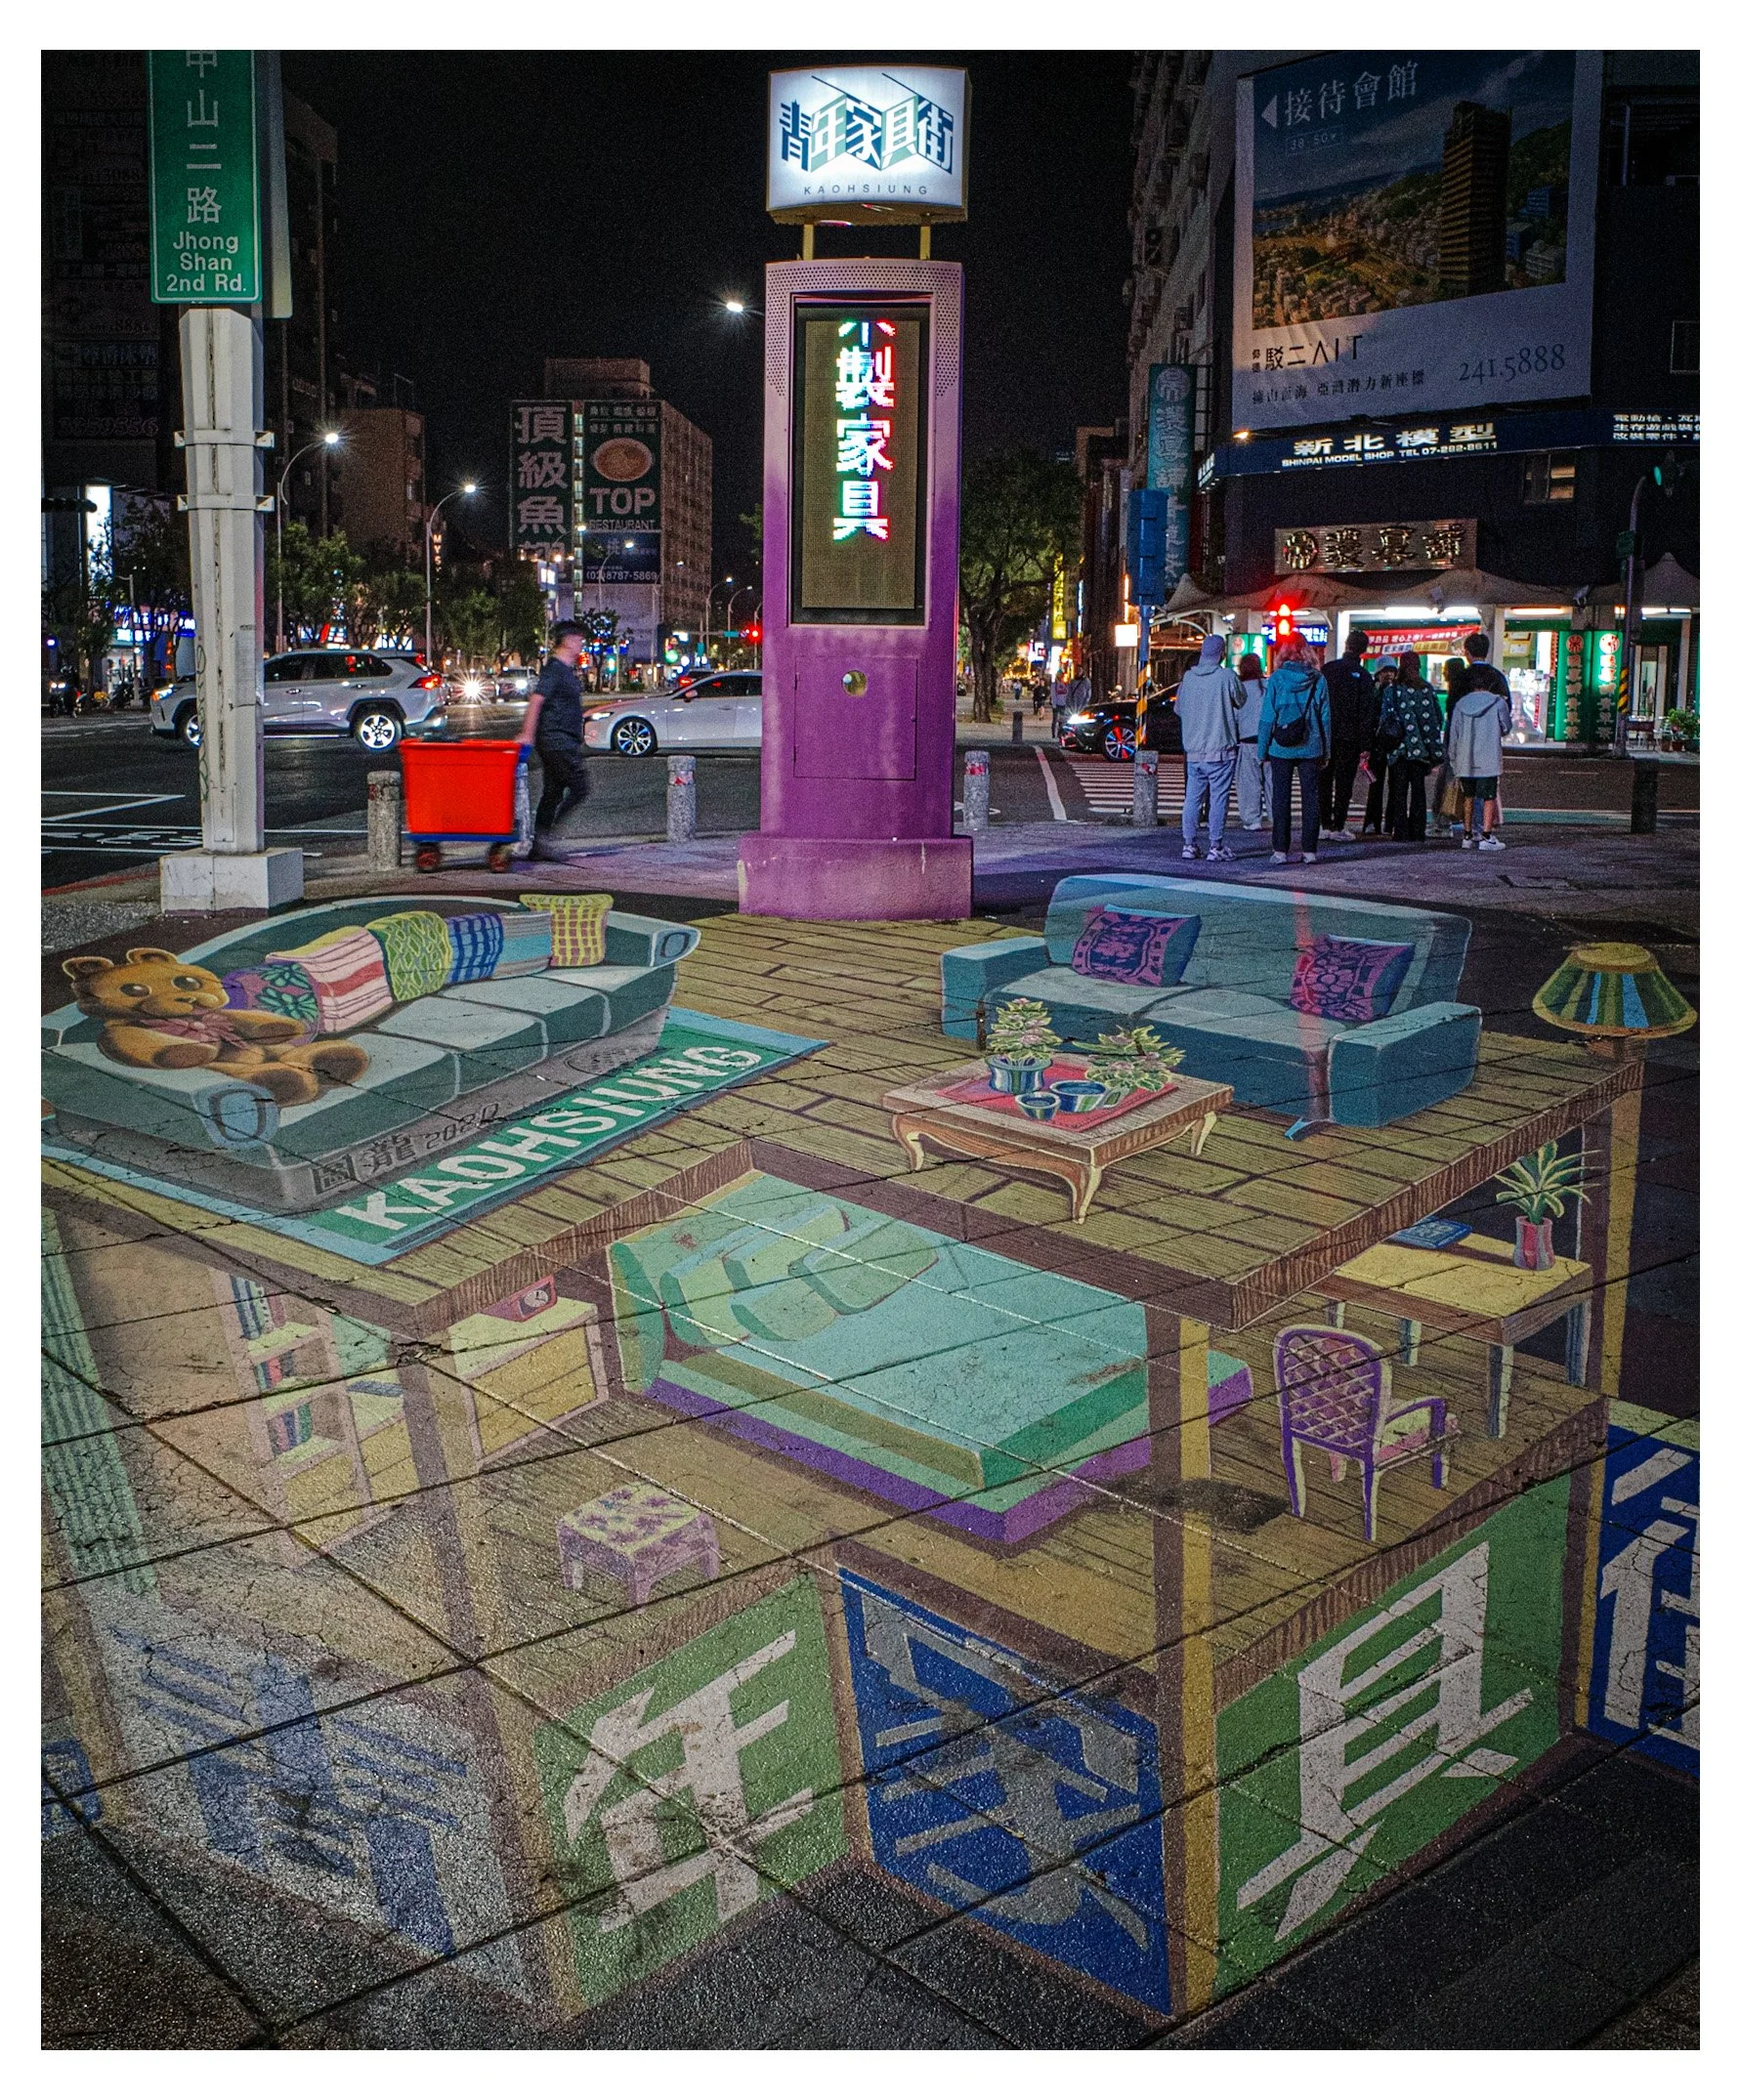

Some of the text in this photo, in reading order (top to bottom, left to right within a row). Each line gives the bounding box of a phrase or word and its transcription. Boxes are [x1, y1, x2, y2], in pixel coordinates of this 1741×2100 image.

[1285, 60, 1419, 126] 接待會館
[186, 50, 222, 224] 中山二路
[779, 94, 955, 175] 青年家具街
[804, 184, 927, 195] KAOHSIUNG
[173, 231, 239, 254] Jhong
[180, 252, 233, 271] Shan
[166, 273, 247, 292] 2nd Rd.
[1459, 344, 1566, 385] 241.5888
[1294, 422, 1497, 456] 新北模型
[1281, 457, 1323, 468] SHINPAI
[1325, 453, 1363, 464] MODEL
[1364, 450, 1395, 461] SHOP
[1399, 448, 1420, 457] TEL
[589, 487, 657, 515] TOP
[589, 519, 656, 530] RESTAURANT
[335, 1046, 762, 1231] KAOHSIUNG
